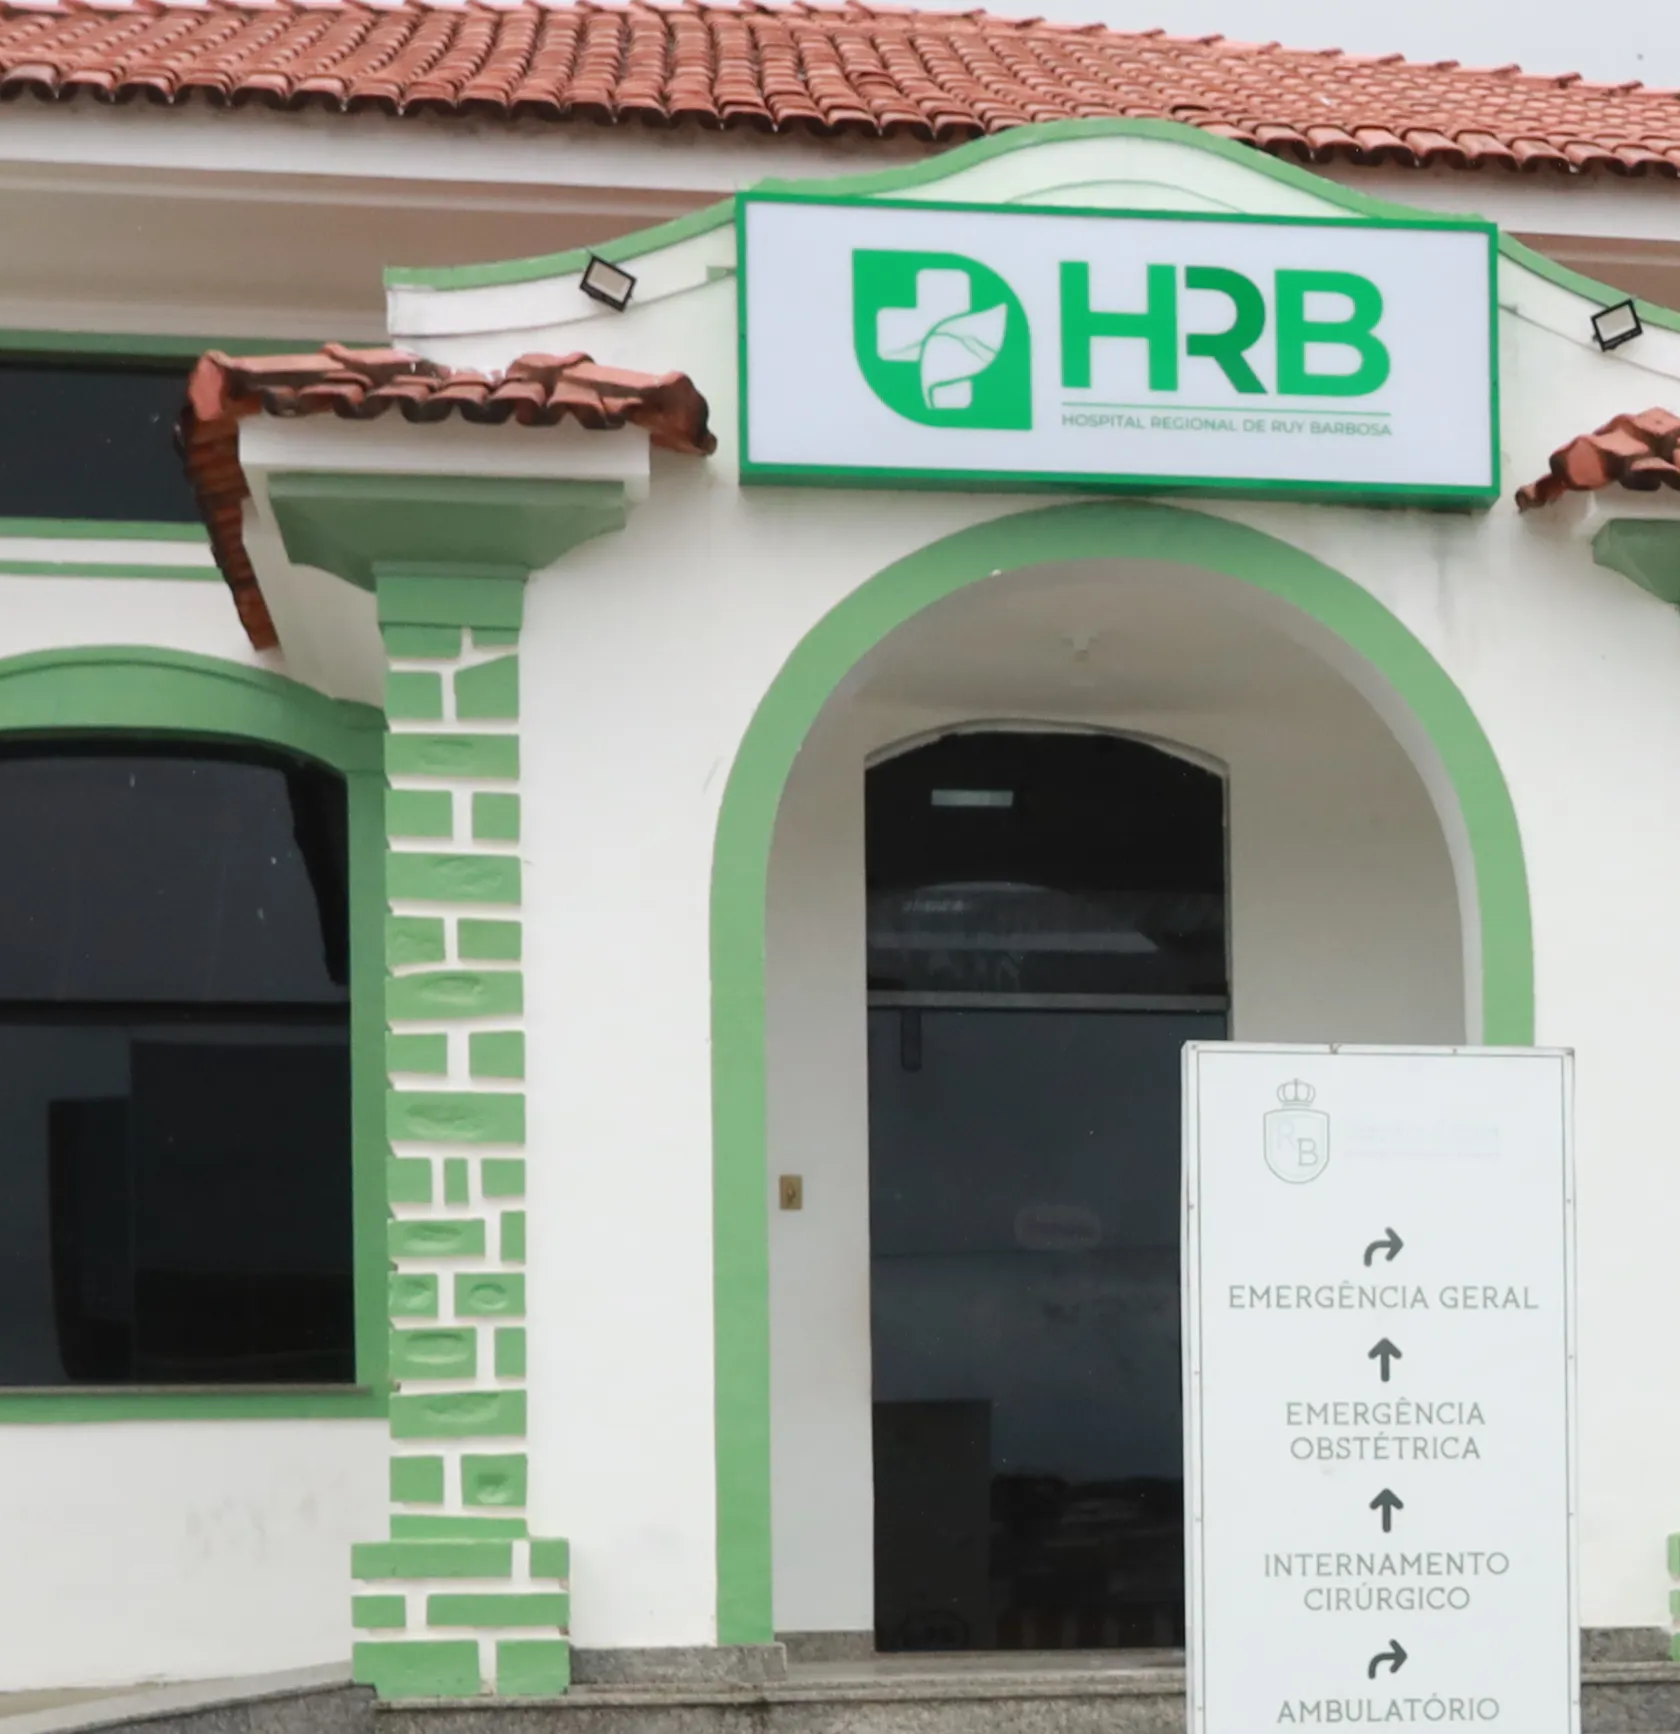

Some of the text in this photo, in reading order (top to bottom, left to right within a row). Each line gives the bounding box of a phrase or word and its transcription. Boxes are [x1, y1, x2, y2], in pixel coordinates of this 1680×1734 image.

[1058, 260, 1392, 397] HRB
[1061, 414, 1393, 436] HOSPITAL REGIONAL DE RUY BARBOSA
[1228, 1280, 1539, 1309] EMERGÊNCIA GERAL
[1286, 1396, 1486, 1425] EMERGÊNCIA
[1290, 1432, 1481, 1460] OBSTÉTRICA
[1264, 1552, 1510, 1577] INTERNAMENTO
[1304, 1582, 1471, 1611] CIRÚRGICO
[1277, 1693, 1501, 1724] AMBULATÓRIO
